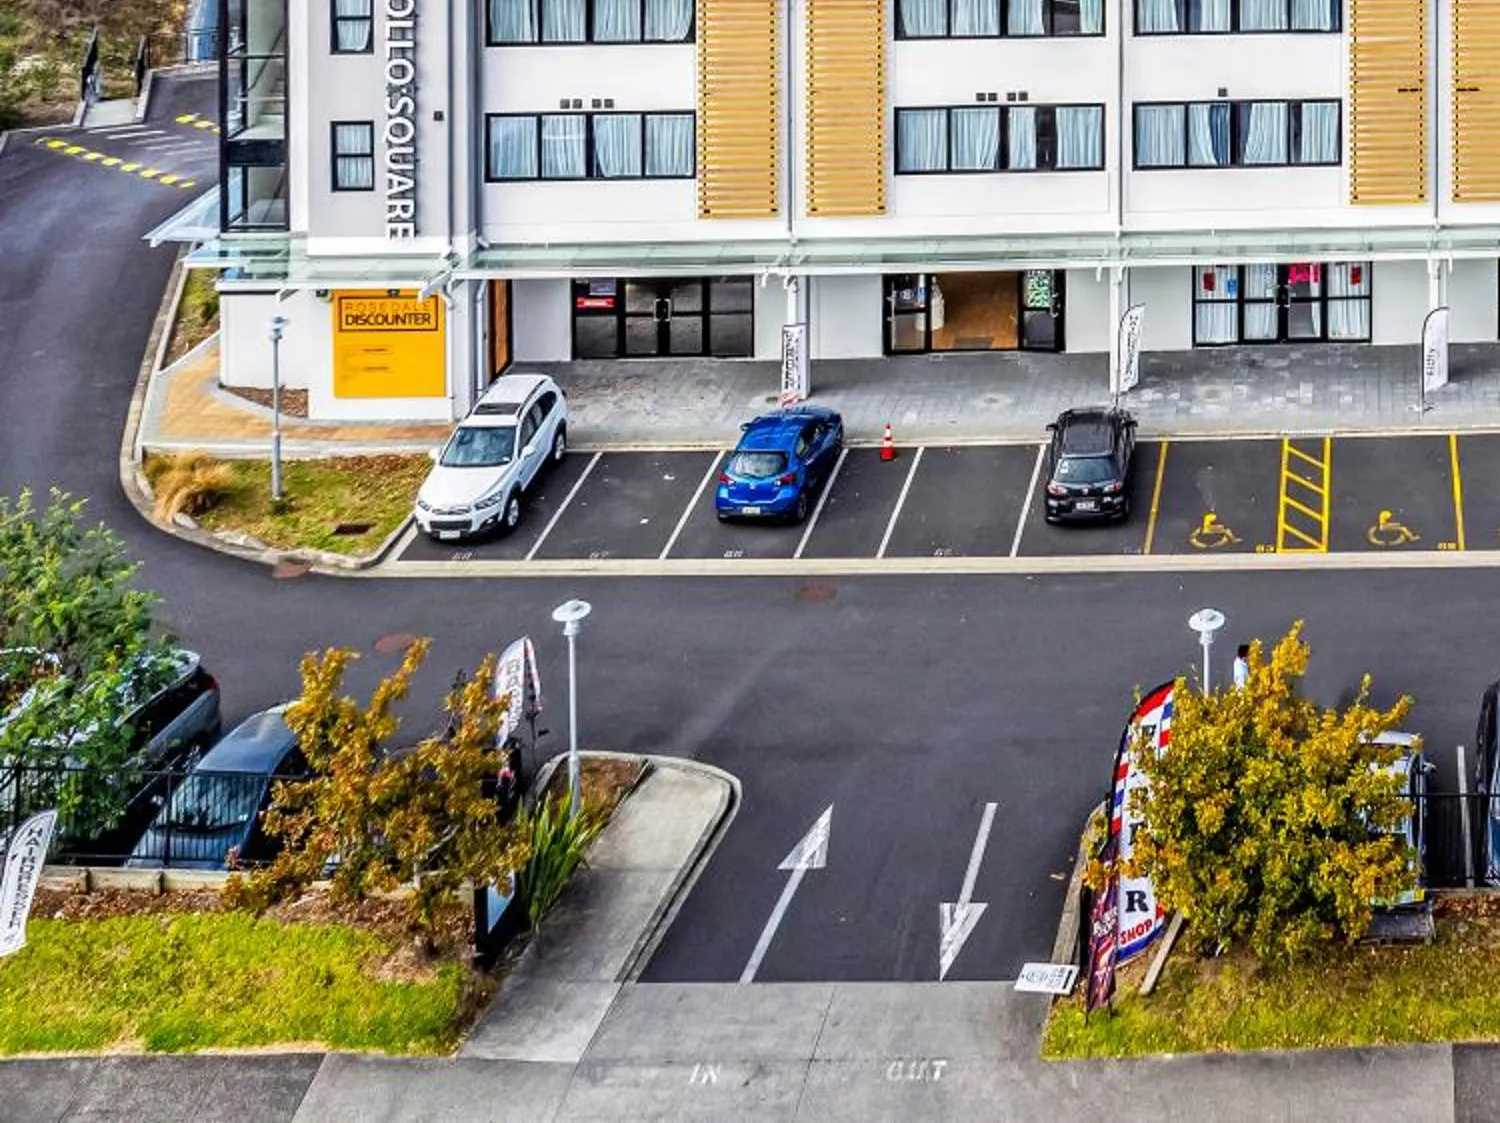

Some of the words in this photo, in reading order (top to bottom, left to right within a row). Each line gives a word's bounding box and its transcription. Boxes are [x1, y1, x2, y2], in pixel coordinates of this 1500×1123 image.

[344, 300, 431, 312] ROSEDALE
[344, 313, 431, 326] DISCOUNTER
[1120, 918, 1153, 945] SHOP
